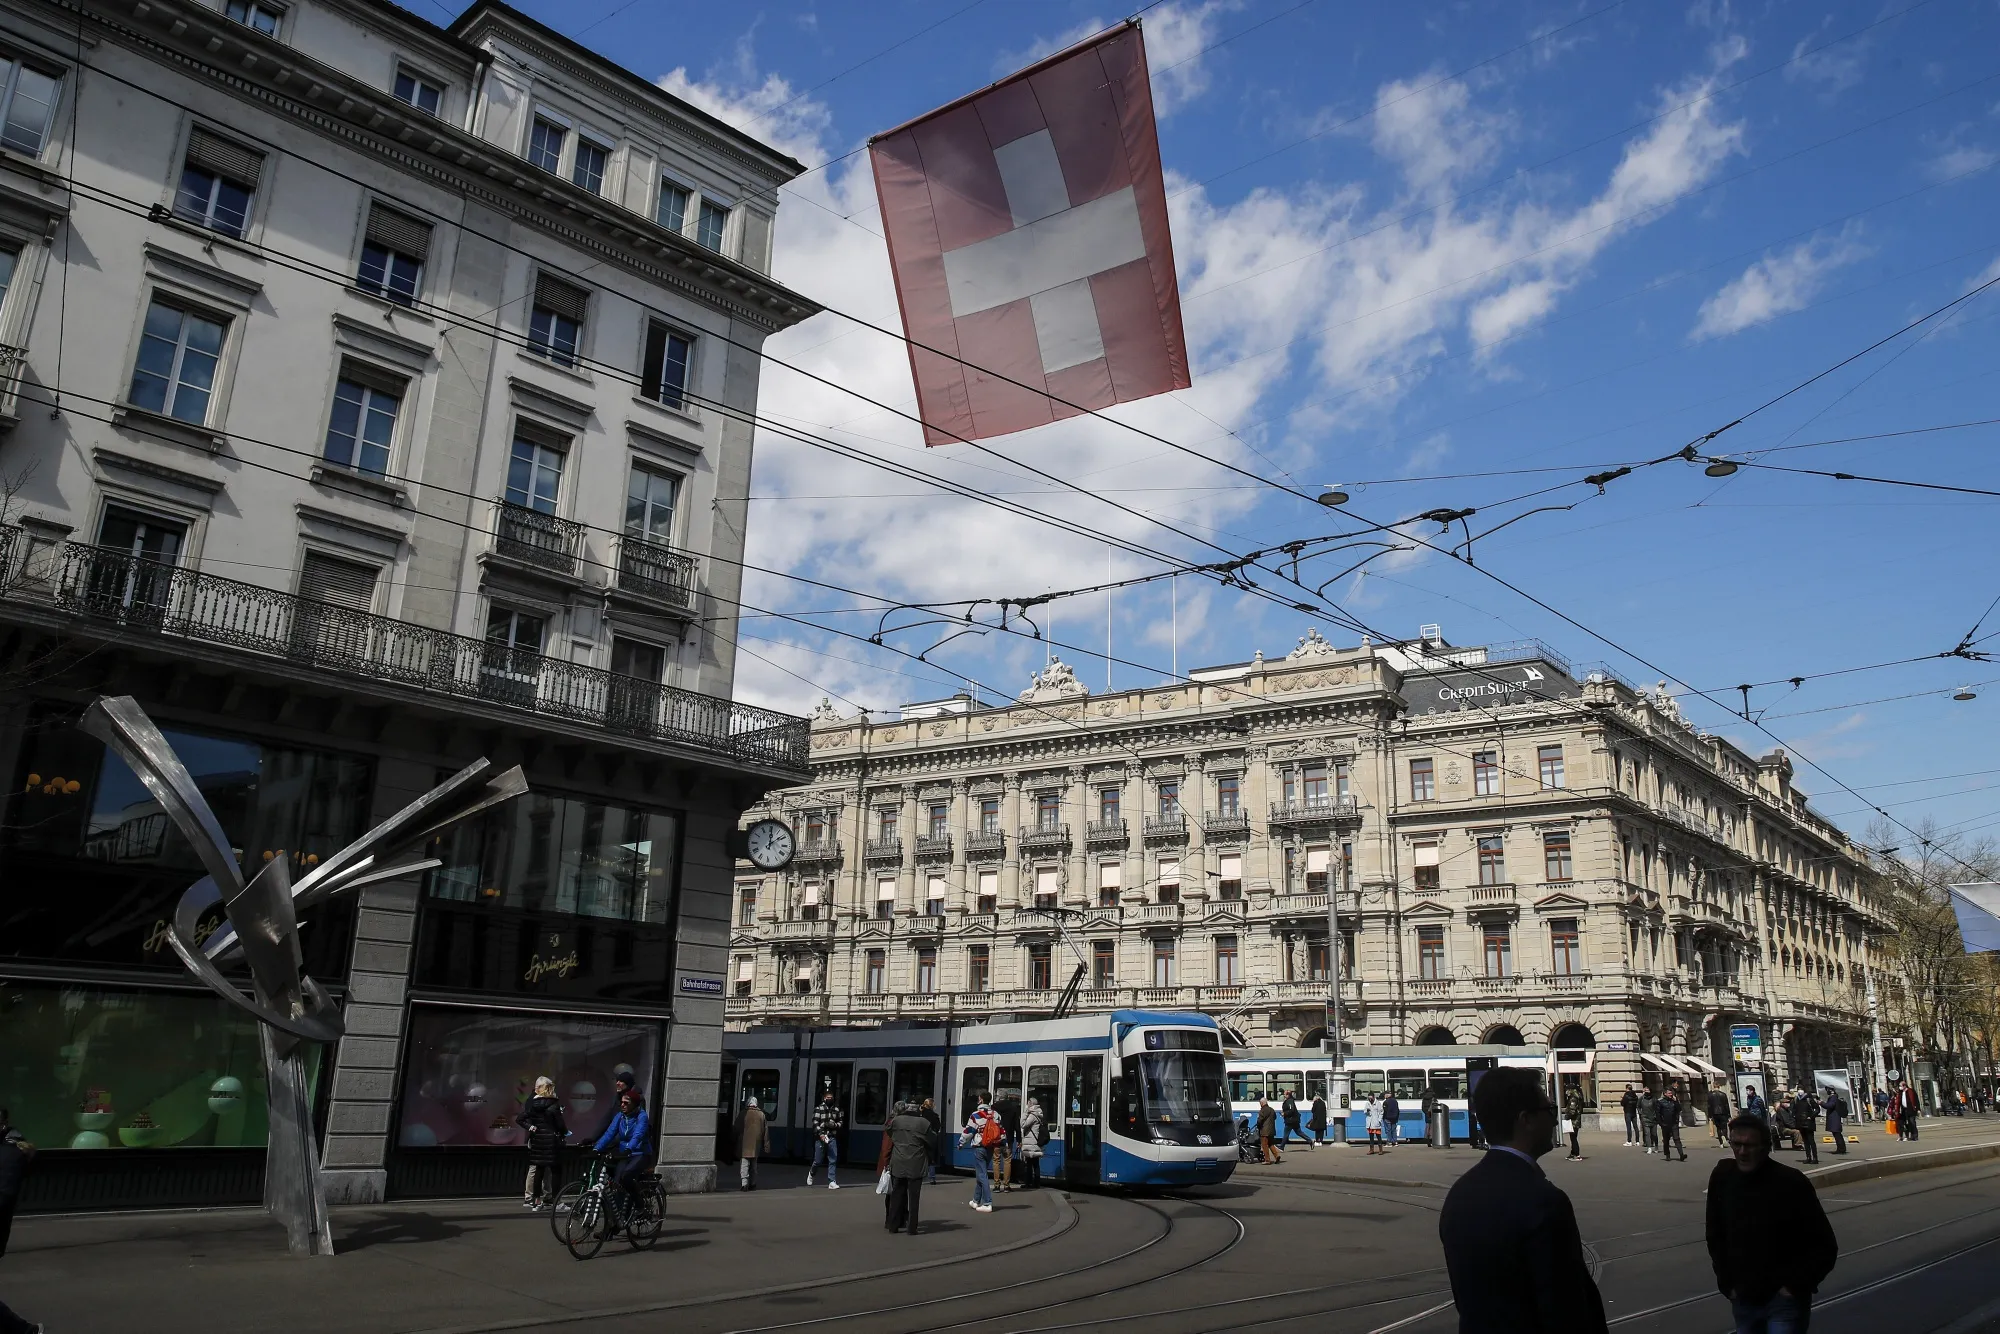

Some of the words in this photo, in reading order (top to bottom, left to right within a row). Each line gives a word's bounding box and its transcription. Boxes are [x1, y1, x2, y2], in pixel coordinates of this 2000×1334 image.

[524, 950, 579, 983] Sprüngli
[682, 978, 721, 991] Bahnhofstrasse
[1150, 1035, 1157, 1045] 9
